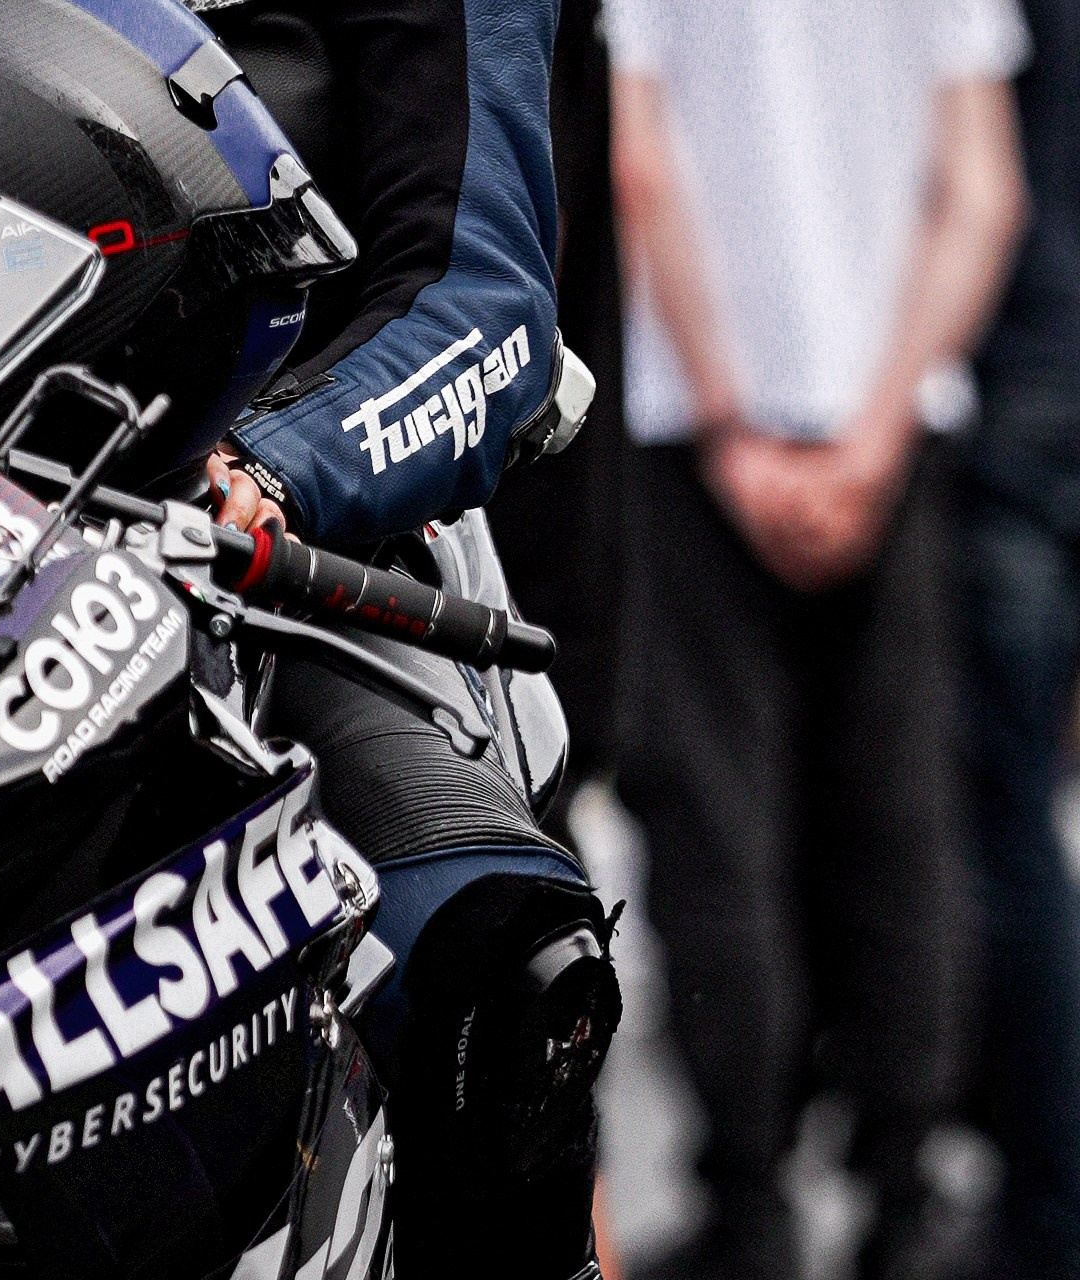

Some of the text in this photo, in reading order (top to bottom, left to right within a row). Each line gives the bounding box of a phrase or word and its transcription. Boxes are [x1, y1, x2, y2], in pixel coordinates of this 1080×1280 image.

[341, 324, 531, 476] Furygan
[42, 608, 184, 784] ROAD RACING TEAM
